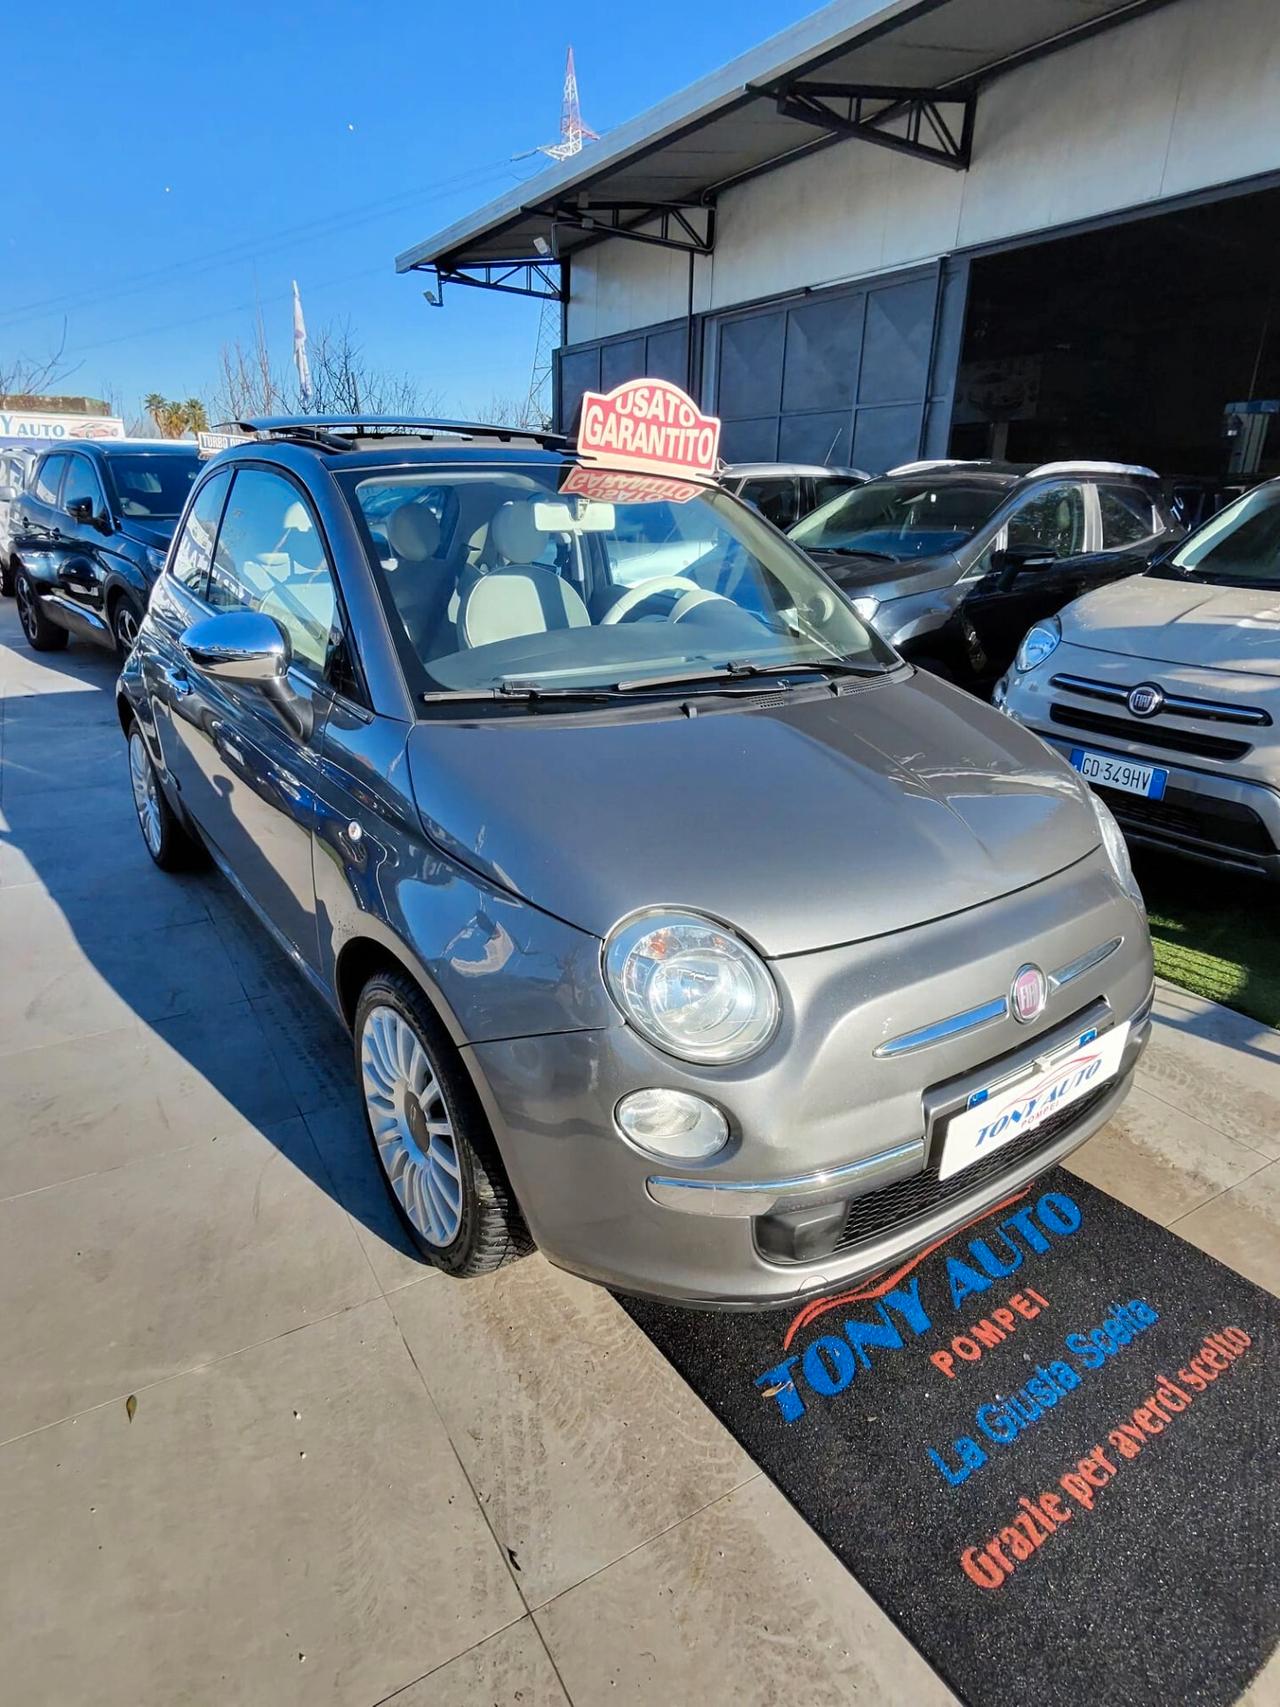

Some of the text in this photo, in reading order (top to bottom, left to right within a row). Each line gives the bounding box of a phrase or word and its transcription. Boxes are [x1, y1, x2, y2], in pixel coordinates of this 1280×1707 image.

[17, 423, 65, 437] AUTO
[585, 405, 714, 465] GARANTITO
[615, 387, 696, 428] USATO
[1135, 694, 1152, 708] FIAT
[975, 1059, 1102, 1147] TONY AUTO
[1021, 1102, 1060, 1129] POMPEI
[753, 1191, 1084, 1424] TONY AUTO
[930, 1287, 1050, 1379] POMPEI
[926, 1298, 1160, 1488] La Giusta Scelta
[959, 1325, 1253, 1590] Grazie per averci scelto
